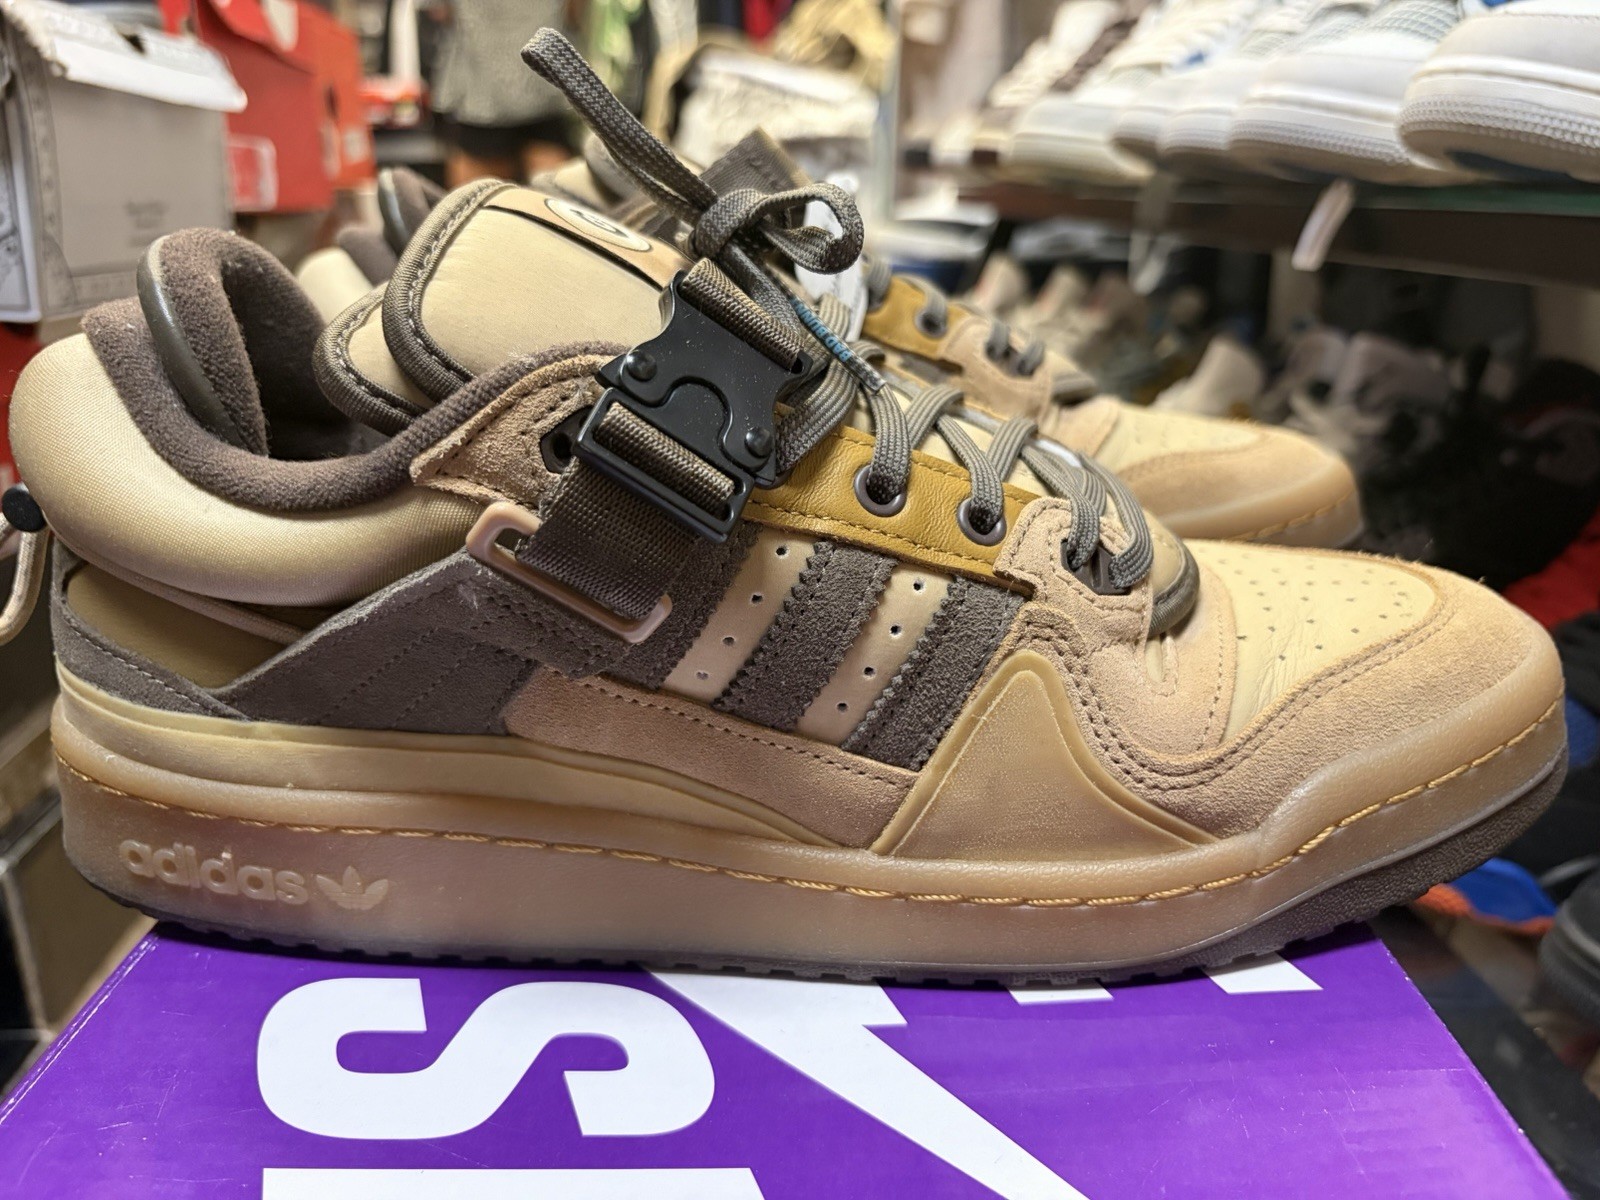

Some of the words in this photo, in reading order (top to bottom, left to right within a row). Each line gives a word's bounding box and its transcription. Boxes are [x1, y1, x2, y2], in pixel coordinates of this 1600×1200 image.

[824, 335, 852, 362] BAD
[118, 838, 308, 905] adidas
[256, 977, 765, 1200] S
